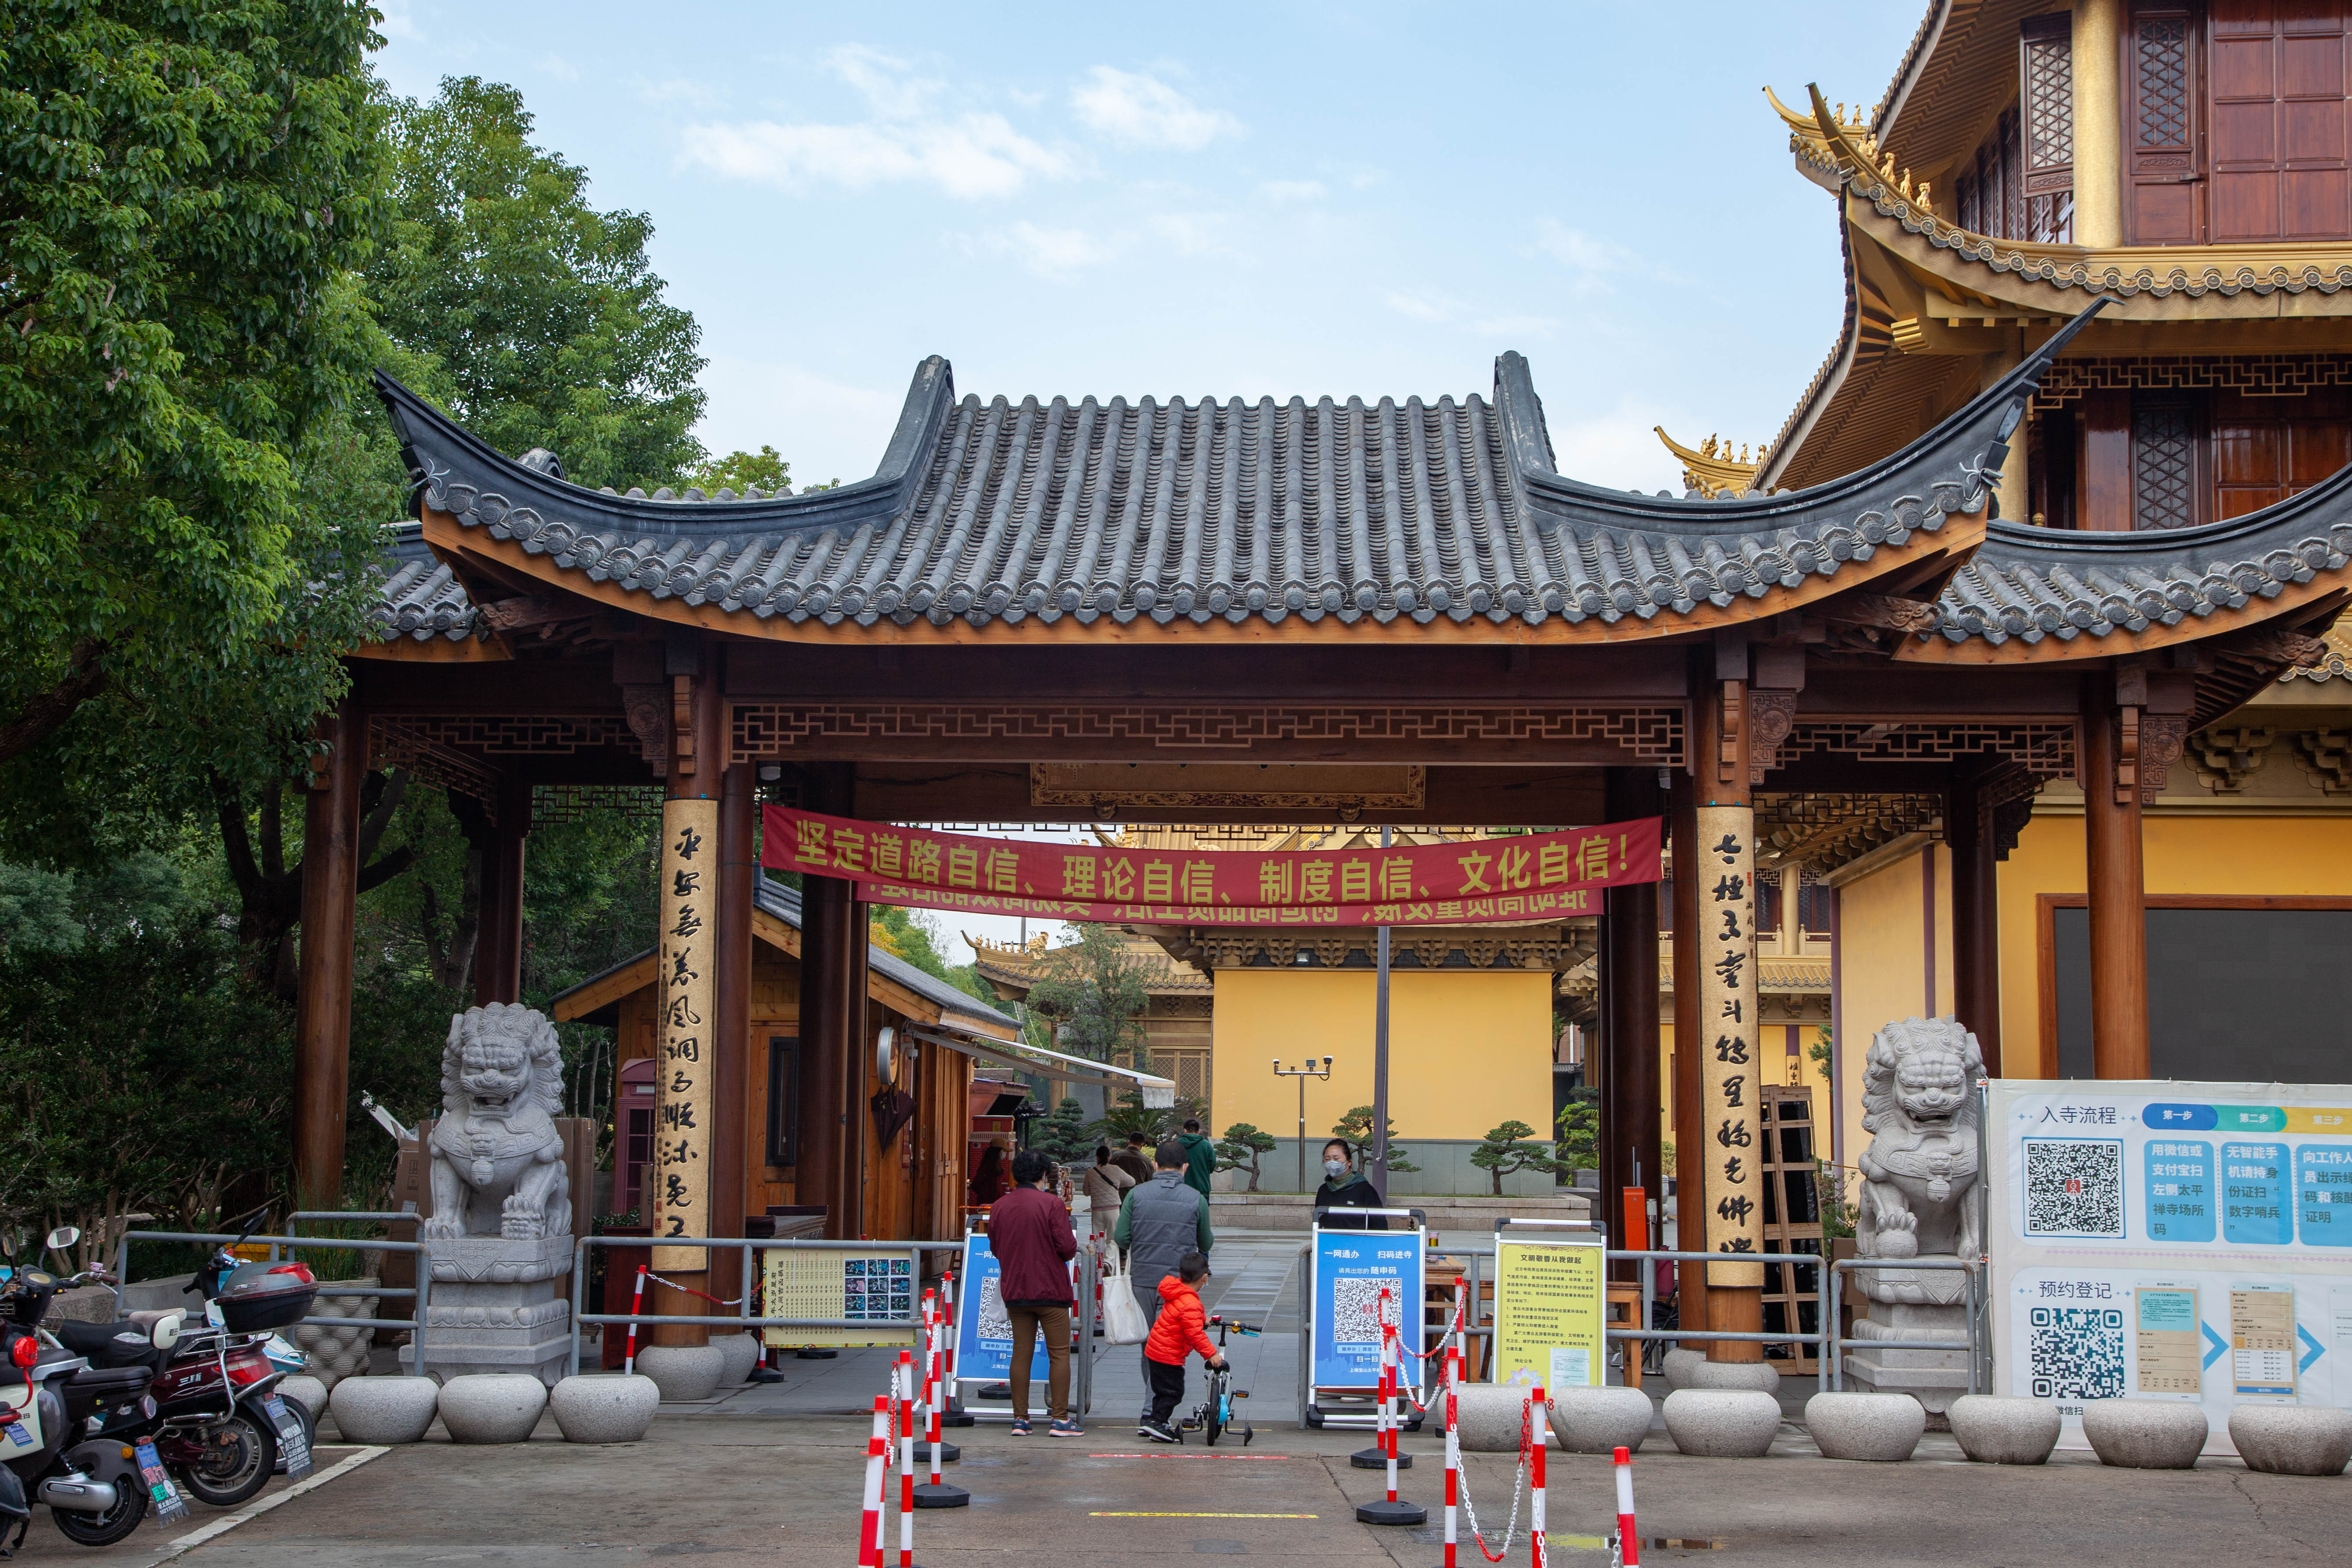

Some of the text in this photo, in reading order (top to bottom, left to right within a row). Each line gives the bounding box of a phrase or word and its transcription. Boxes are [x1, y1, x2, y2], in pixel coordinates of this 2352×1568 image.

[795, 819, 1034, 896] 坚定道路自信、
[1062, 854, 1232, 905] 理论自信、
[1259, 856, 1431, 904] 制度自信、
[2039, 1105, 2117, 1126] 入寺流程
[2162, 1109, 2193, 1121] 第一步
[2239, 1112, 2269, 1124] 第二步
[2312, 1115, 2344, 1125] 第三步
[2151, 1143, 2203, 1157] 用微信或
[2227, 1146, 2279, 1160] 无智能手
[2302, 1151, 2352, 1164] 向工作人
[2151, 1163, 2203, 1178] 支付宝扫
[2227, 1165, 2279, 1179] 机请持身
[2304, 1171, 2352, 1184] 员出示绿
[2152, 1183, 2204, 1197] 左侧太平
[2152, 1203, 2205, 1218] 禅寺场所
[2228, 1205, 2281, 1218] 数字哨兵
[2305, 1211, 2331, 1223] 证明
[2154, 1223, 2166, 1236] 码
[1324, 1250, 1413, 1259] 一网通办 扫码进寺
[1520, 1254, 1582, 1264] 文明敬香从我做起
[1370, 1266, 1397, 1275] 随申码
[2039, 1280, 2112, 1300] 预约登记
